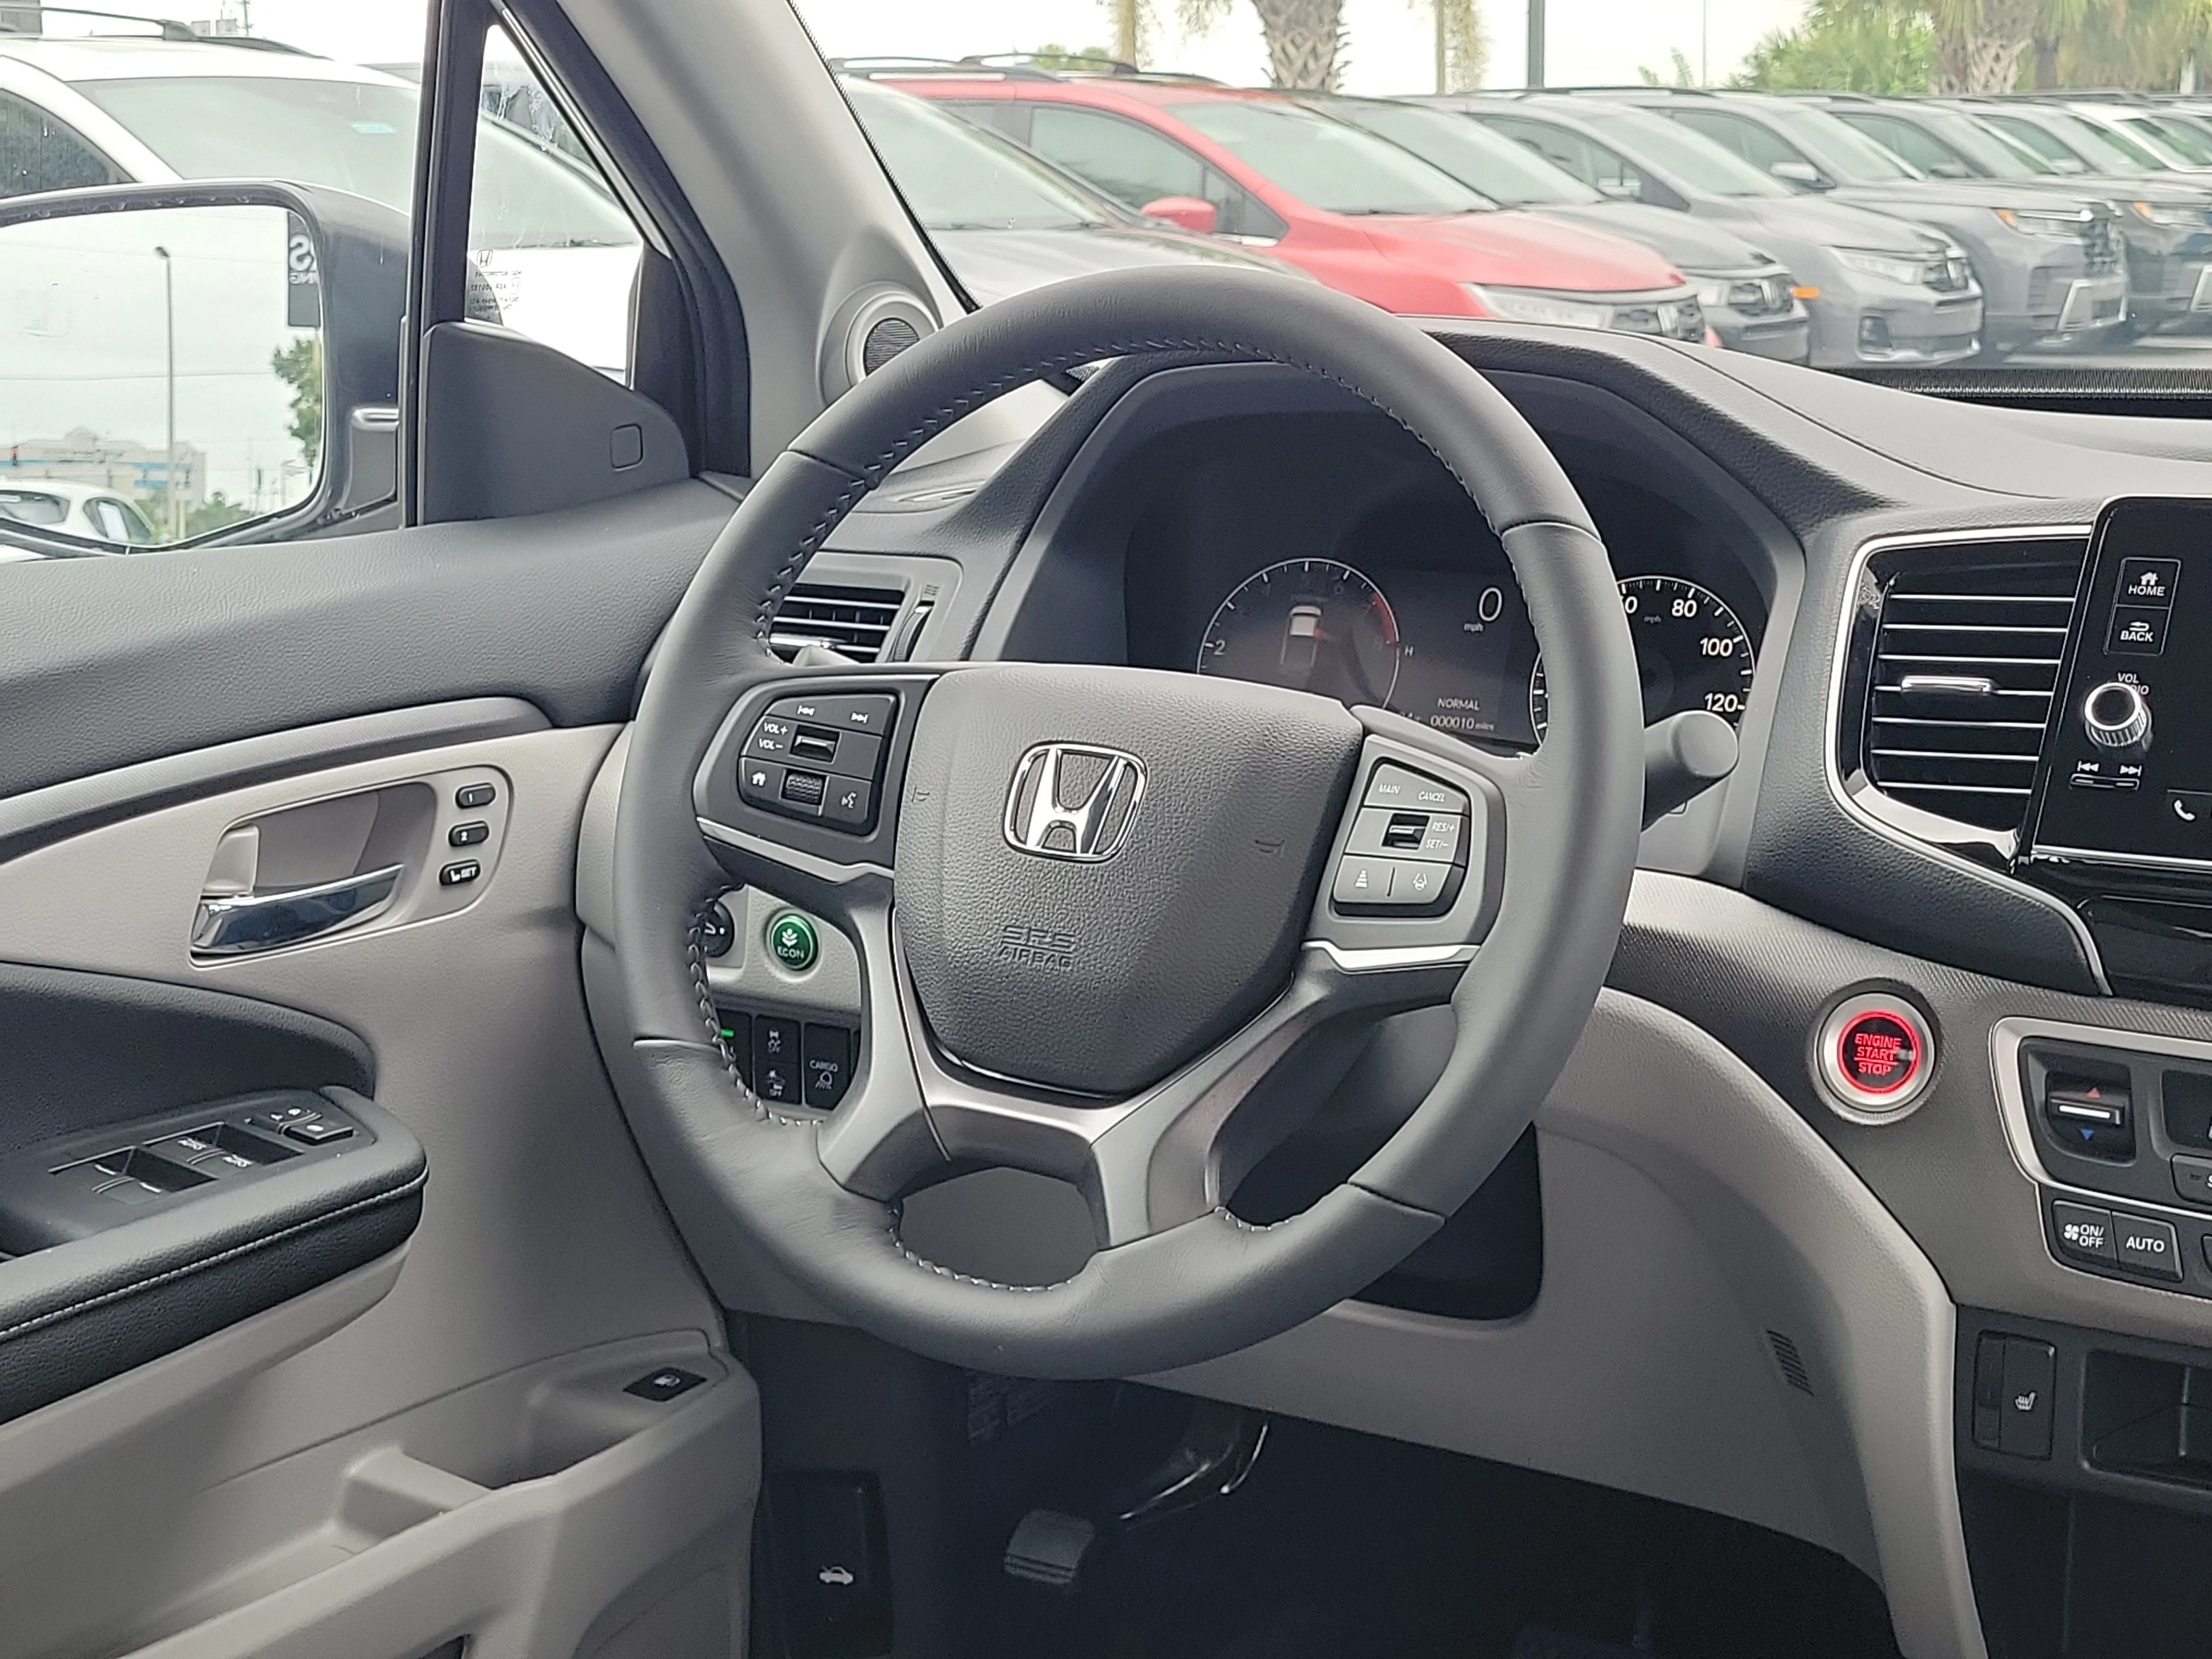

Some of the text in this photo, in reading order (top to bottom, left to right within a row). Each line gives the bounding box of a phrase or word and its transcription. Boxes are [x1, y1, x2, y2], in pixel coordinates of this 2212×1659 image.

[2128, 584, 2165, 596] HOME
[1479, 586, 1503, 622] 0
[1622, 596, 1638, 614] 0
[1672, 599, 1697, 617] 80
[1464, 623, 1483, 633] mph
[2120, 630, 2153, 642] BACK
[1214, 640, 1226, 656] 2
[1405, 646, 1414, 656] H
[1700, 638, 1733, 657] 100
[2118, 672, 2139, 683] VOL
[1437, 698, 1480, 710] NORMAL
[1705, 693, 1737, 712] 120
[1430, 715, 1475, 729] 000010
[1379, 785, 1400, 794] MAIN
[467, 793, 473, 803] 1
[1418, 791, 1445, 803] CANCEL
[461, 831, 468, 841] 2
[1002, 925, 1075, 949] SRS
[777, 946, 805, 959] ECON
[999, 946, 1072, 968] AIRBAG
[1854, 1033, 1903, 1049] ENGINE
[1857, 1046, 1896, 1061] START
[809, 1059, 838, 1072] CARGO
[1859, 1062, 1891, 1075] STOP
[2080, 1224, 2105, 1238] ON/
[2078, 1236, 2104, 1249] OFF
[2125, 1236, 2165, 1253] AUTO
